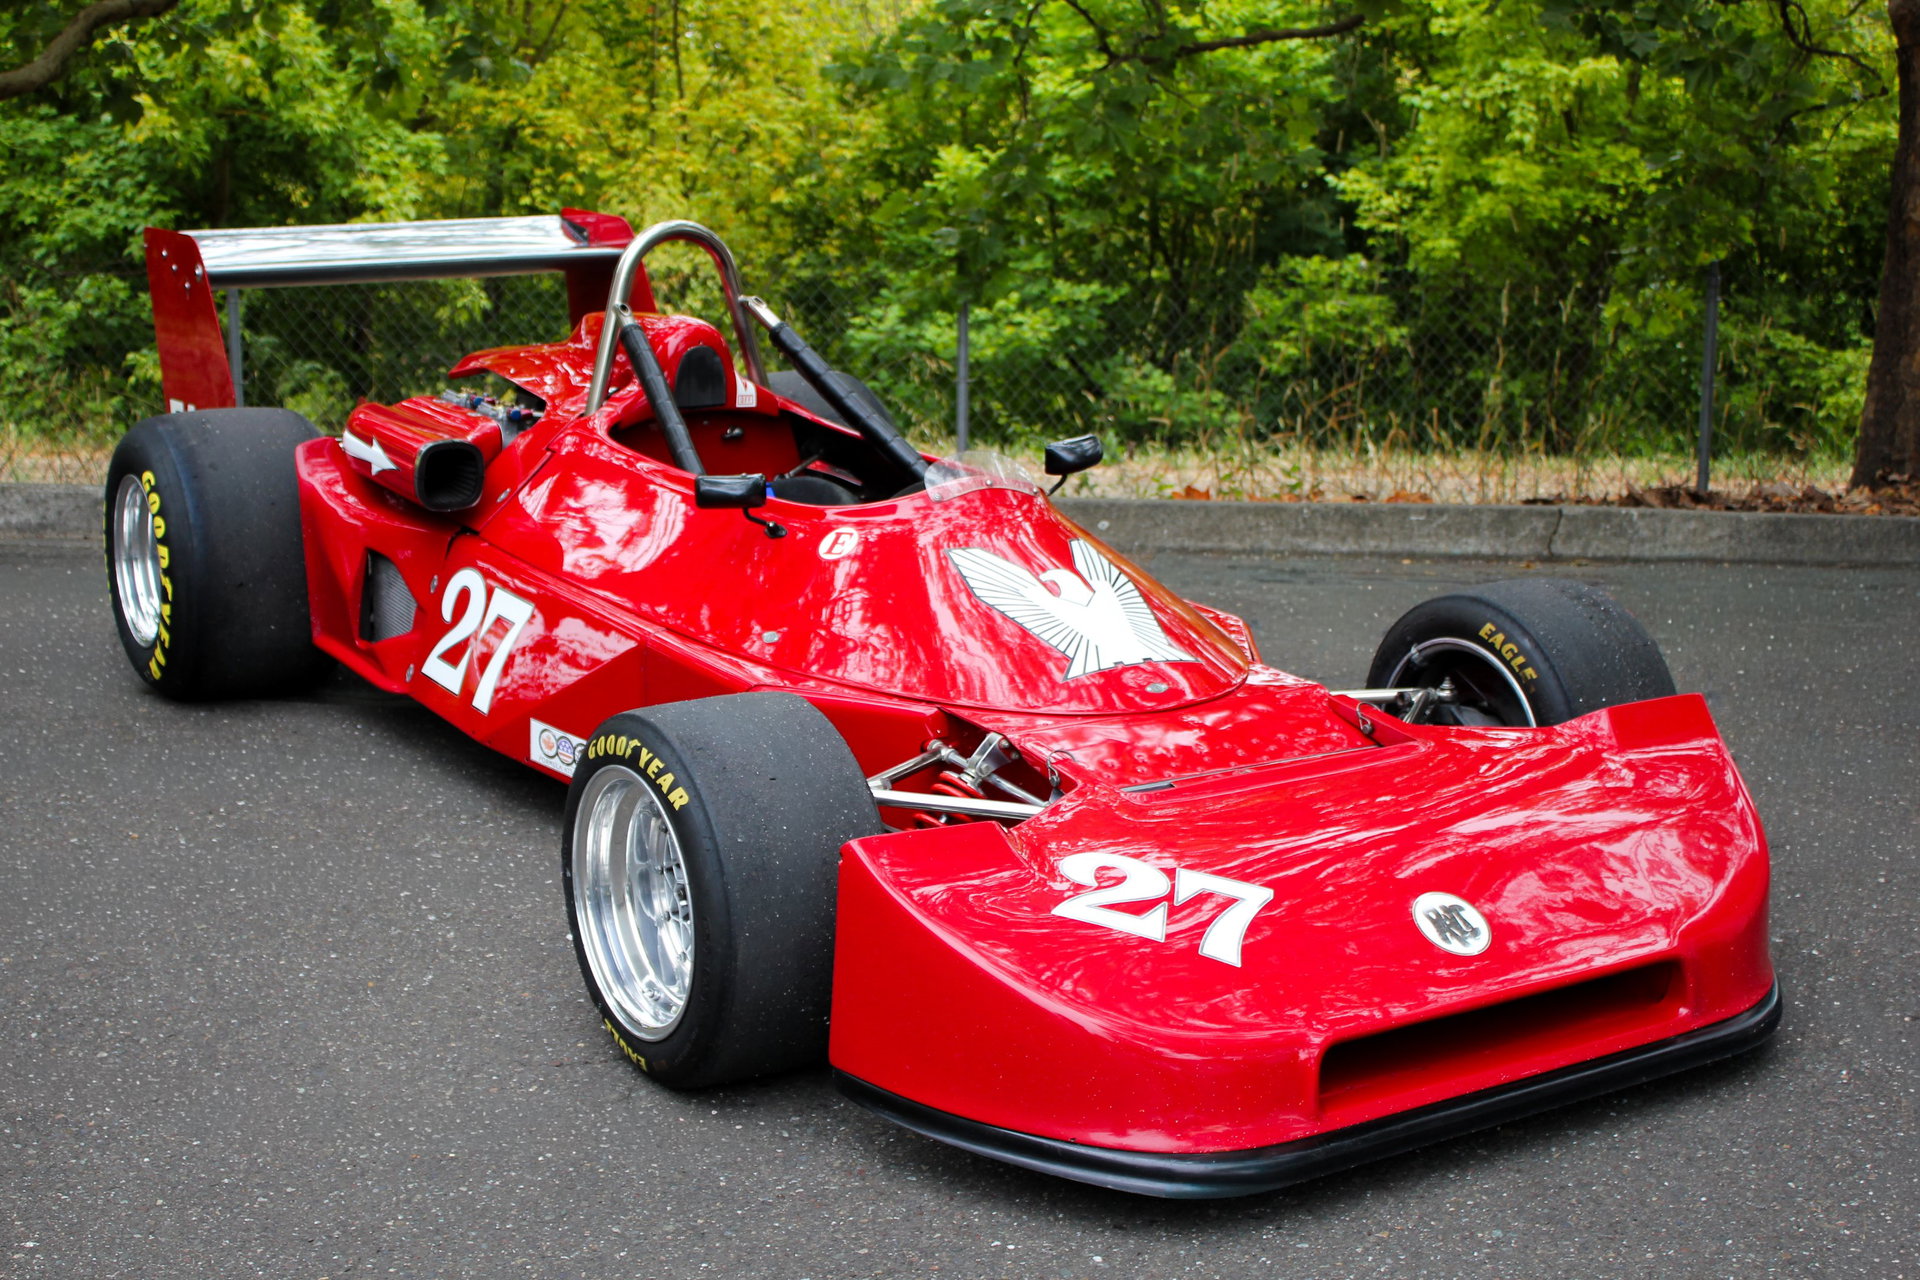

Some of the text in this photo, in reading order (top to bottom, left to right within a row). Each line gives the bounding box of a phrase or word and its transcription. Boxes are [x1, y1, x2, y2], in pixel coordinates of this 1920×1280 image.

[823, 531, 854, 555] E
[421, 567, 535, 717] 27
[1478, 622, 1539, 681] EAGLE
[587, 734, 690, 812] GOODYEAR
[1051, 851, 1275, 968] 27
